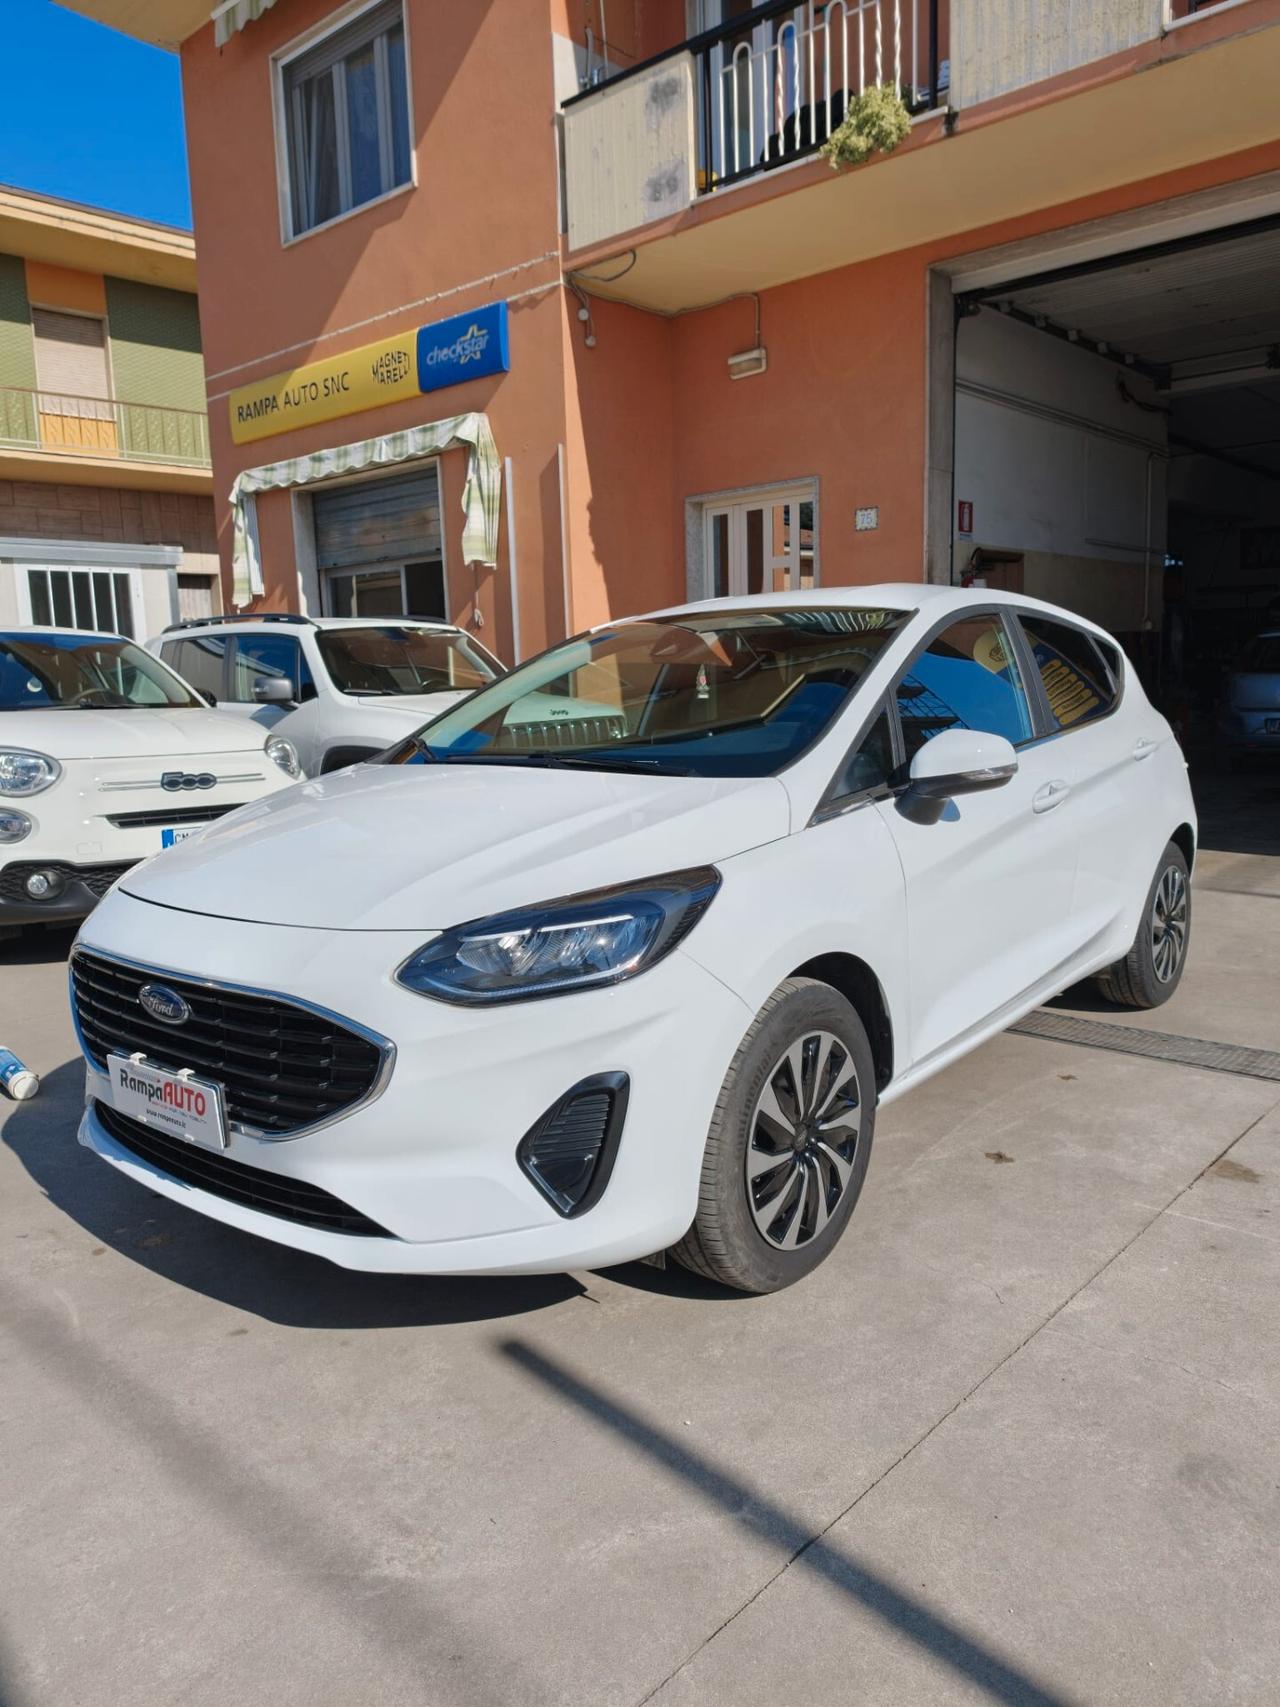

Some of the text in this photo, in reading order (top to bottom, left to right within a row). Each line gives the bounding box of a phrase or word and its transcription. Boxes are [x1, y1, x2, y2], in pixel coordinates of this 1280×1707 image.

[426, 335, 489, 365] checkstar
[237, 371, 350, 422] RAMPA AUTO SNC
[860, 512, 873, 525] 75
[160, 771, 217, 792] 500
